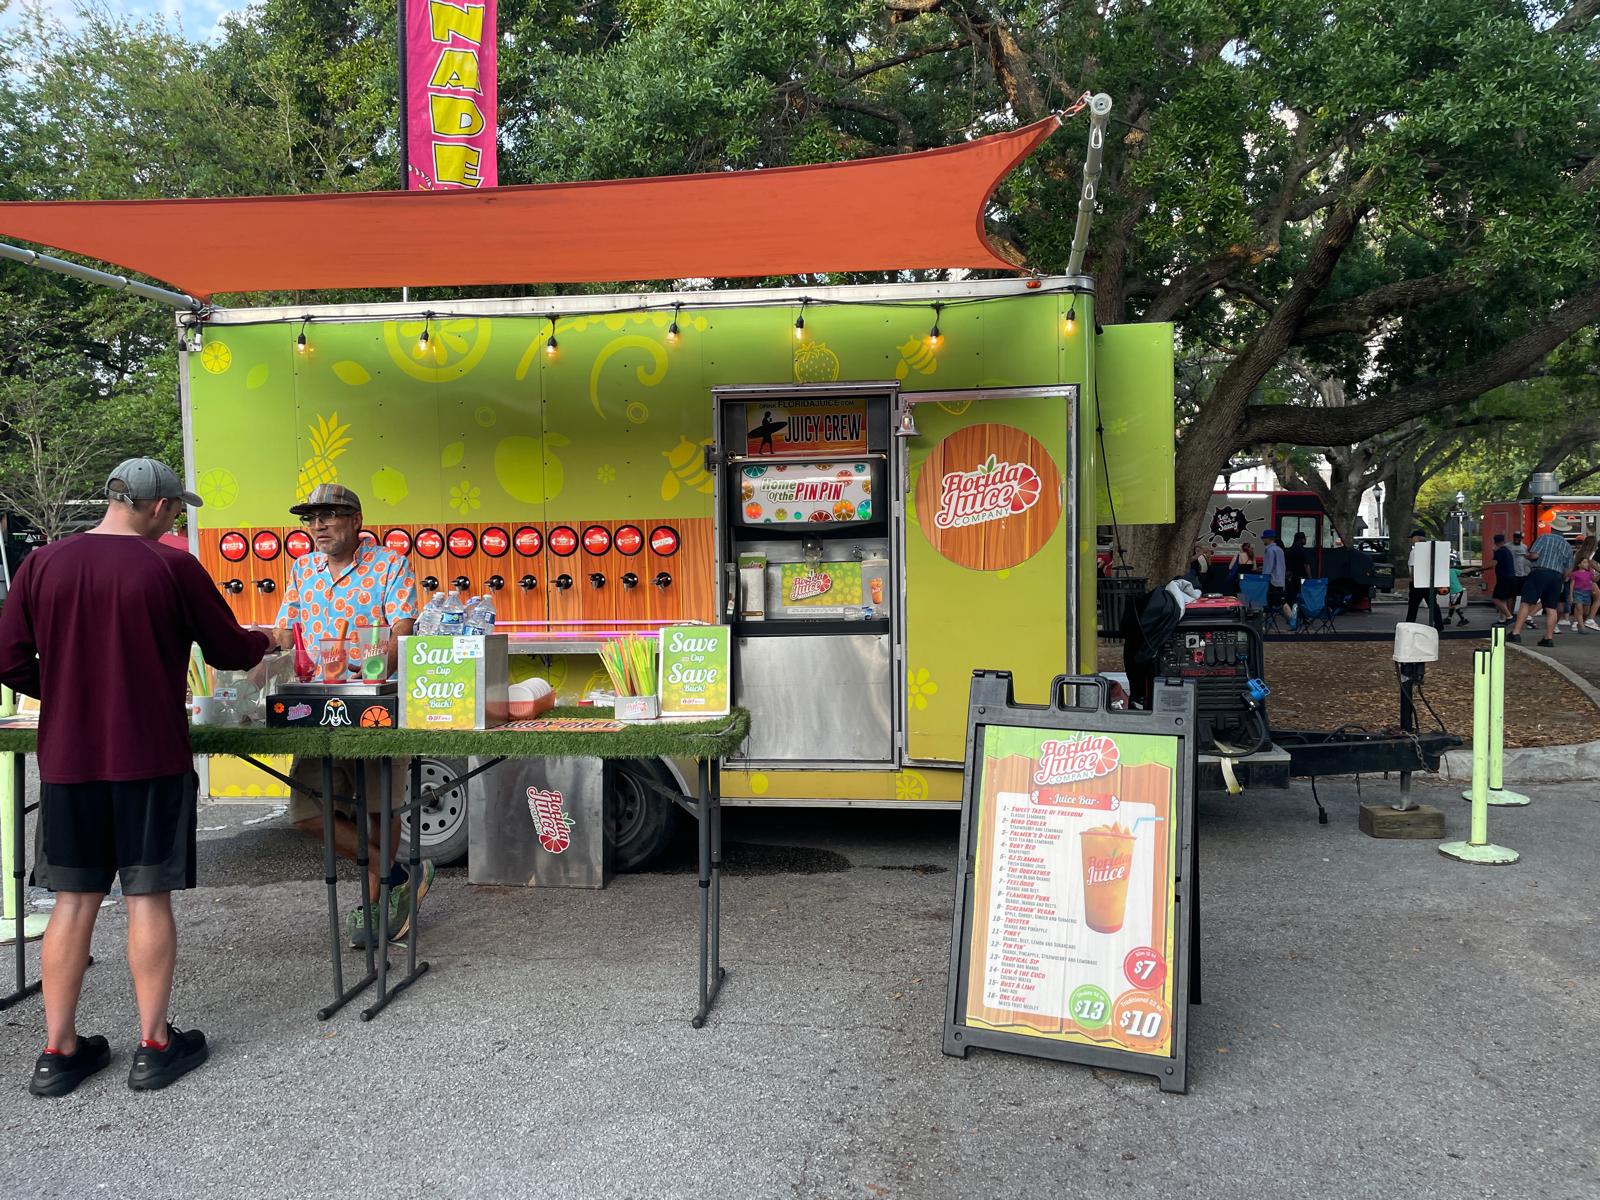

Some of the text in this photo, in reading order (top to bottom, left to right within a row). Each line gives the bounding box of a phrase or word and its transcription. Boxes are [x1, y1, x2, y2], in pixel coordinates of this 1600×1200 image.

[784, 414, 861, 442] JUICY CREW
[762, 478, 796, 490] Home
[944, 464, 1018, 493] Florida
[778, 490, 794, 500] the
[937, 485, 1014, 526] Juice
[955, 508, 1009, 525] COMPANY
[669, 632, 718, 652] Save
[690, 654, 704, 662] Cup
[436, 666, 450, 676] Cup
[668, 663, 718, 683] Save
[412, 676, 464, 698] Save
[1043, 736, 1102, 756] Florida
[1035, 753, 1097, 782] Juice
[1050, 772, 1094, 783] COMPANY
[1053, 794, 1096, 804] Juice Bar
[528, 788, 556, 836] Juice
[549, 792, 571, 840] Florida
[1087, 865, 1124, 885] Juice
[1134, 960, 1156, 980] $7
[1075, 1000, 1105, 1020] $13
[1120, 1010, 1161, 1038] $10
